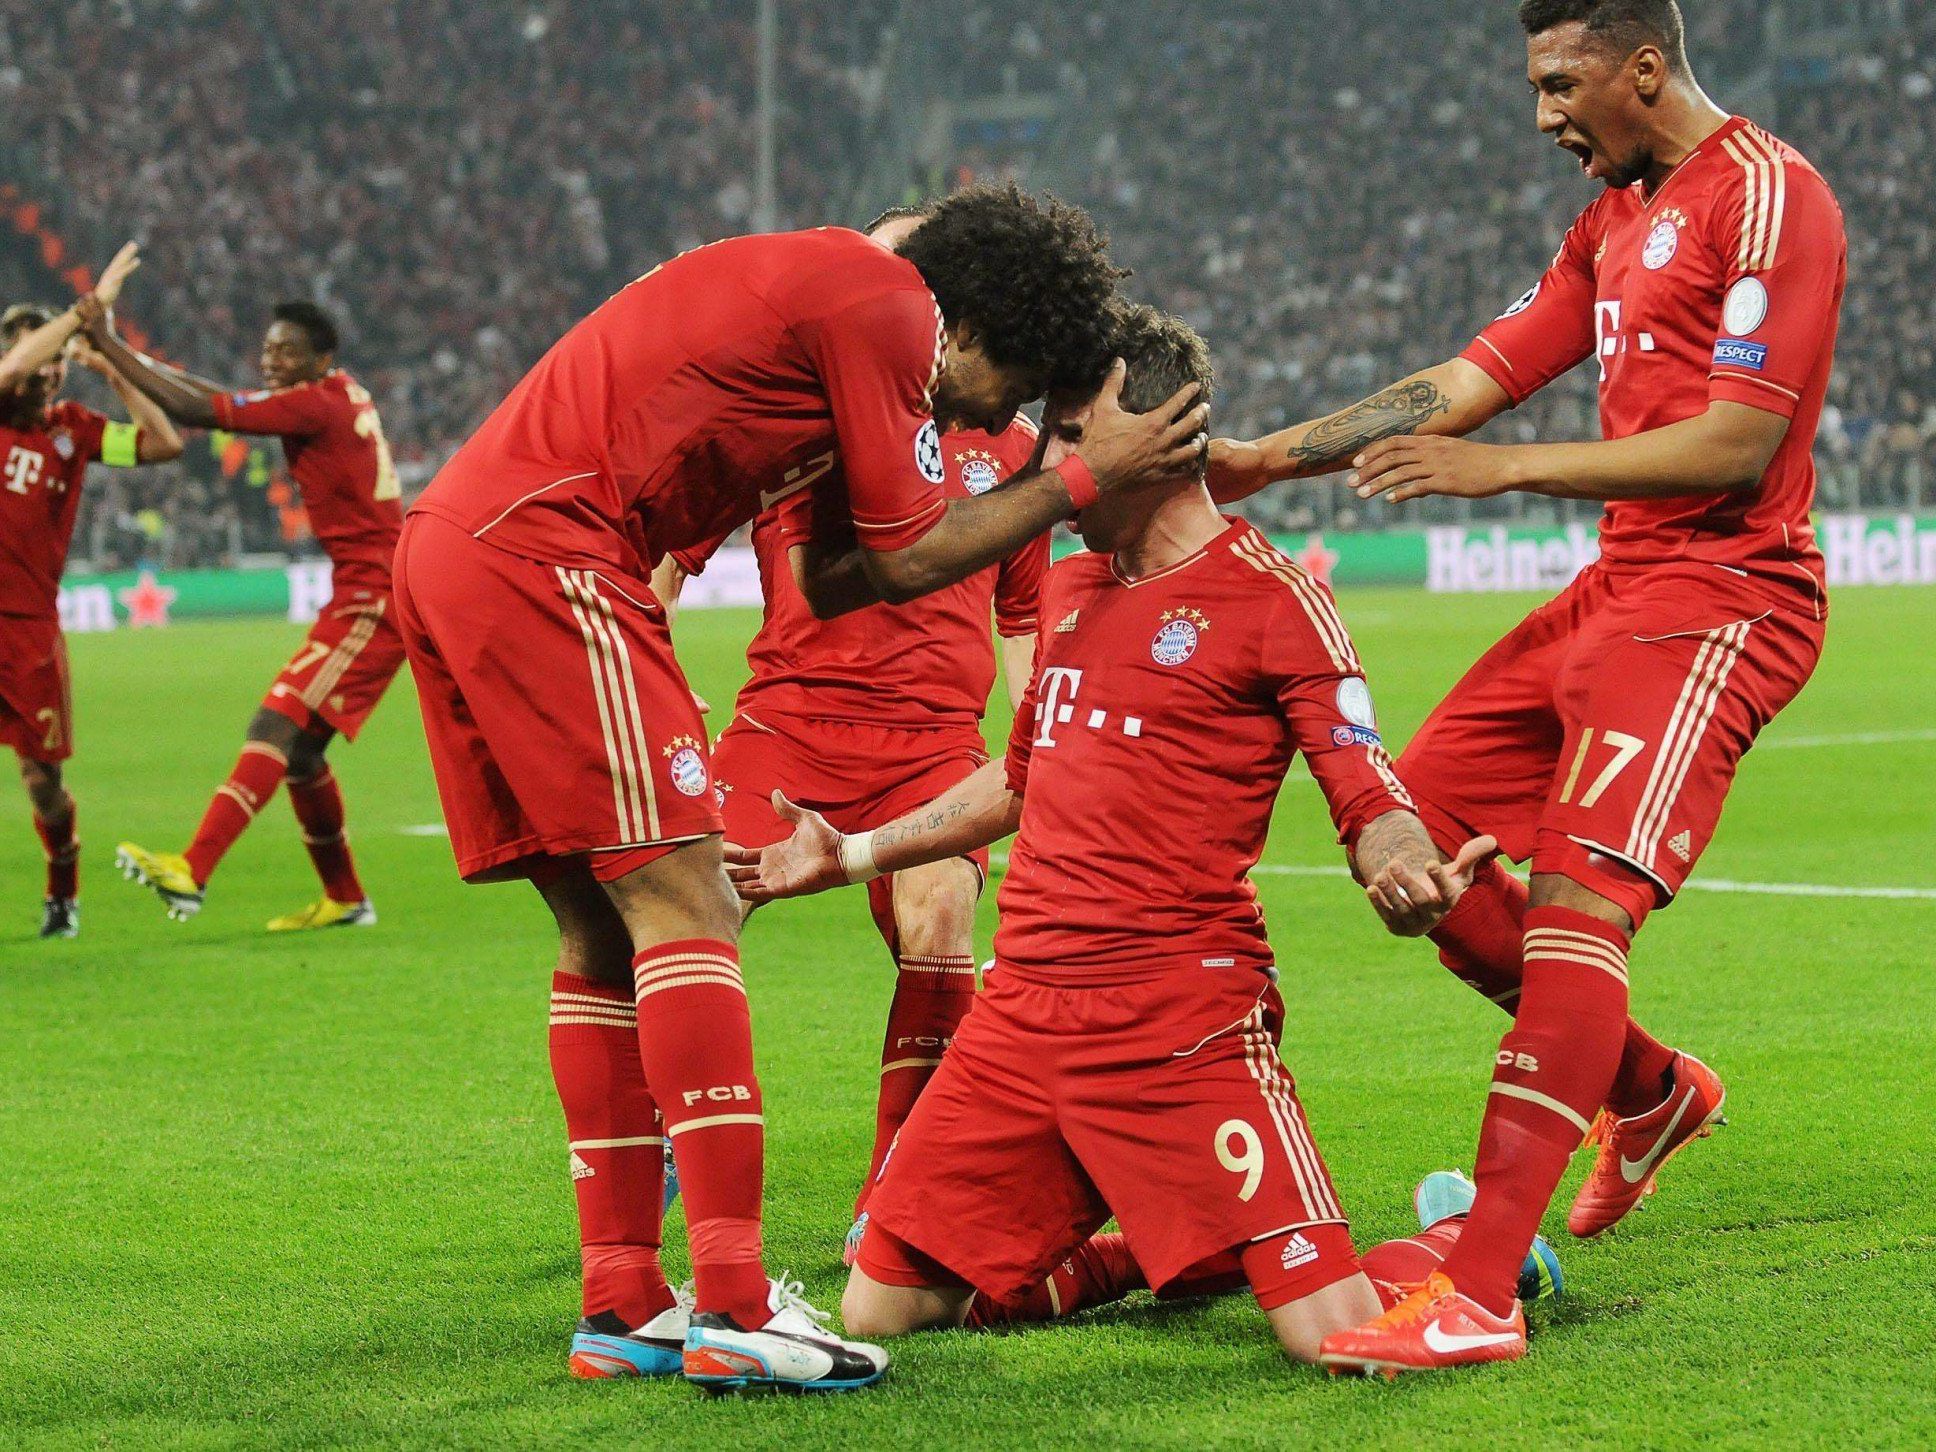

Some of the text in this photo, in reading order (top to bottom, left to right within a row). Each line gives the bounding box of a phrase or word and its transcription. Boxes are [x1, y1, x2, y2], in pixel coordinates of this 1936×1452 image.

[1558, 727, 1647, 808] 17
[1496, 1050, 1539, 1072] CB
[682, 1085, 752, 1107] FCB
[1214, 1119, 1264, 1203] 9
[1281, 1242, 1317, 1261] adidas
